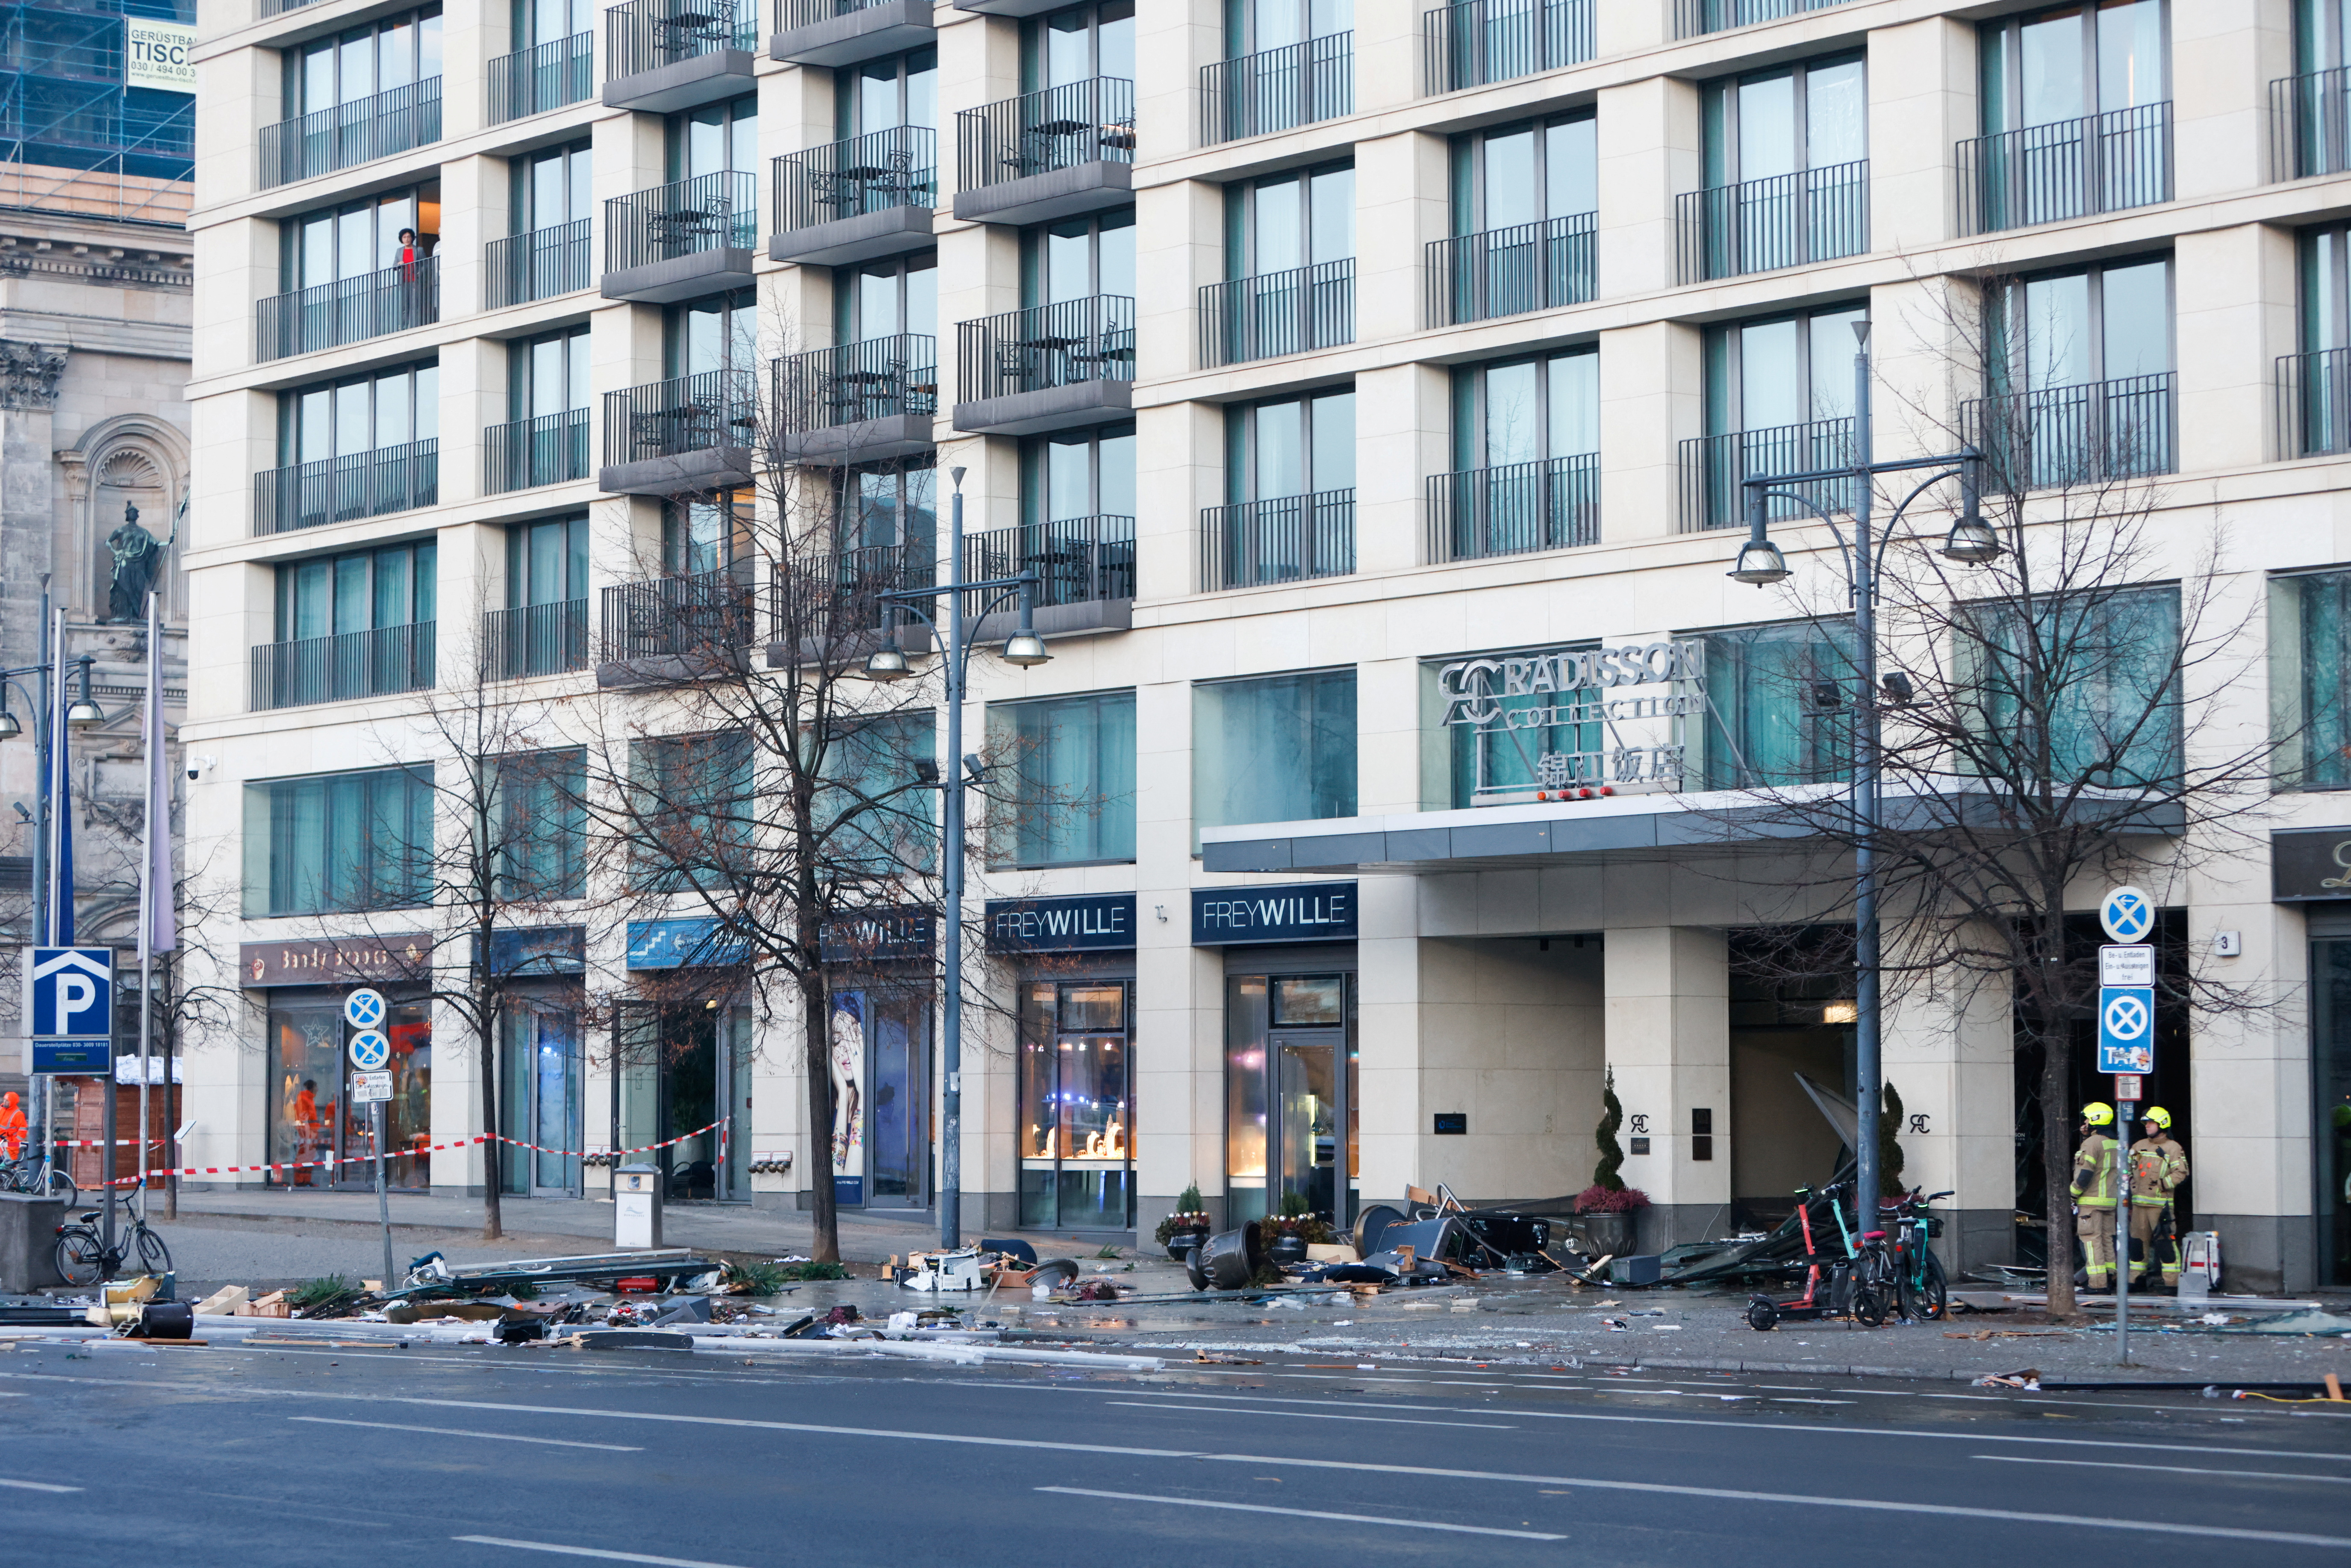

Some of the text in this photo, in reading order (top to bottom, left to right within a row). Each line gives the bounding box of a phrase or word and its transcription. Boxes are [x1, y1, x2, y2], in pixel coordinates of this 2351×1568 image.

[131, 61, 147, 71] 030
[156, 65, 173, 74] 494
[176, 67, 187, 76] 00
[132, 41, 191, 66] TISC
[1504, 639, 1706, 697] RADISSON
[1507, 693, 1707, 730] COLLECTION
[996, 907, 1125, 937] FREYWILLE
[1204, 895, 1345, 928] FREYWILLE
[2221, 936, 2228, 949] 3
[56, 973, 96, 1035] P
[2104, 1046, 2147, 1065] TA
